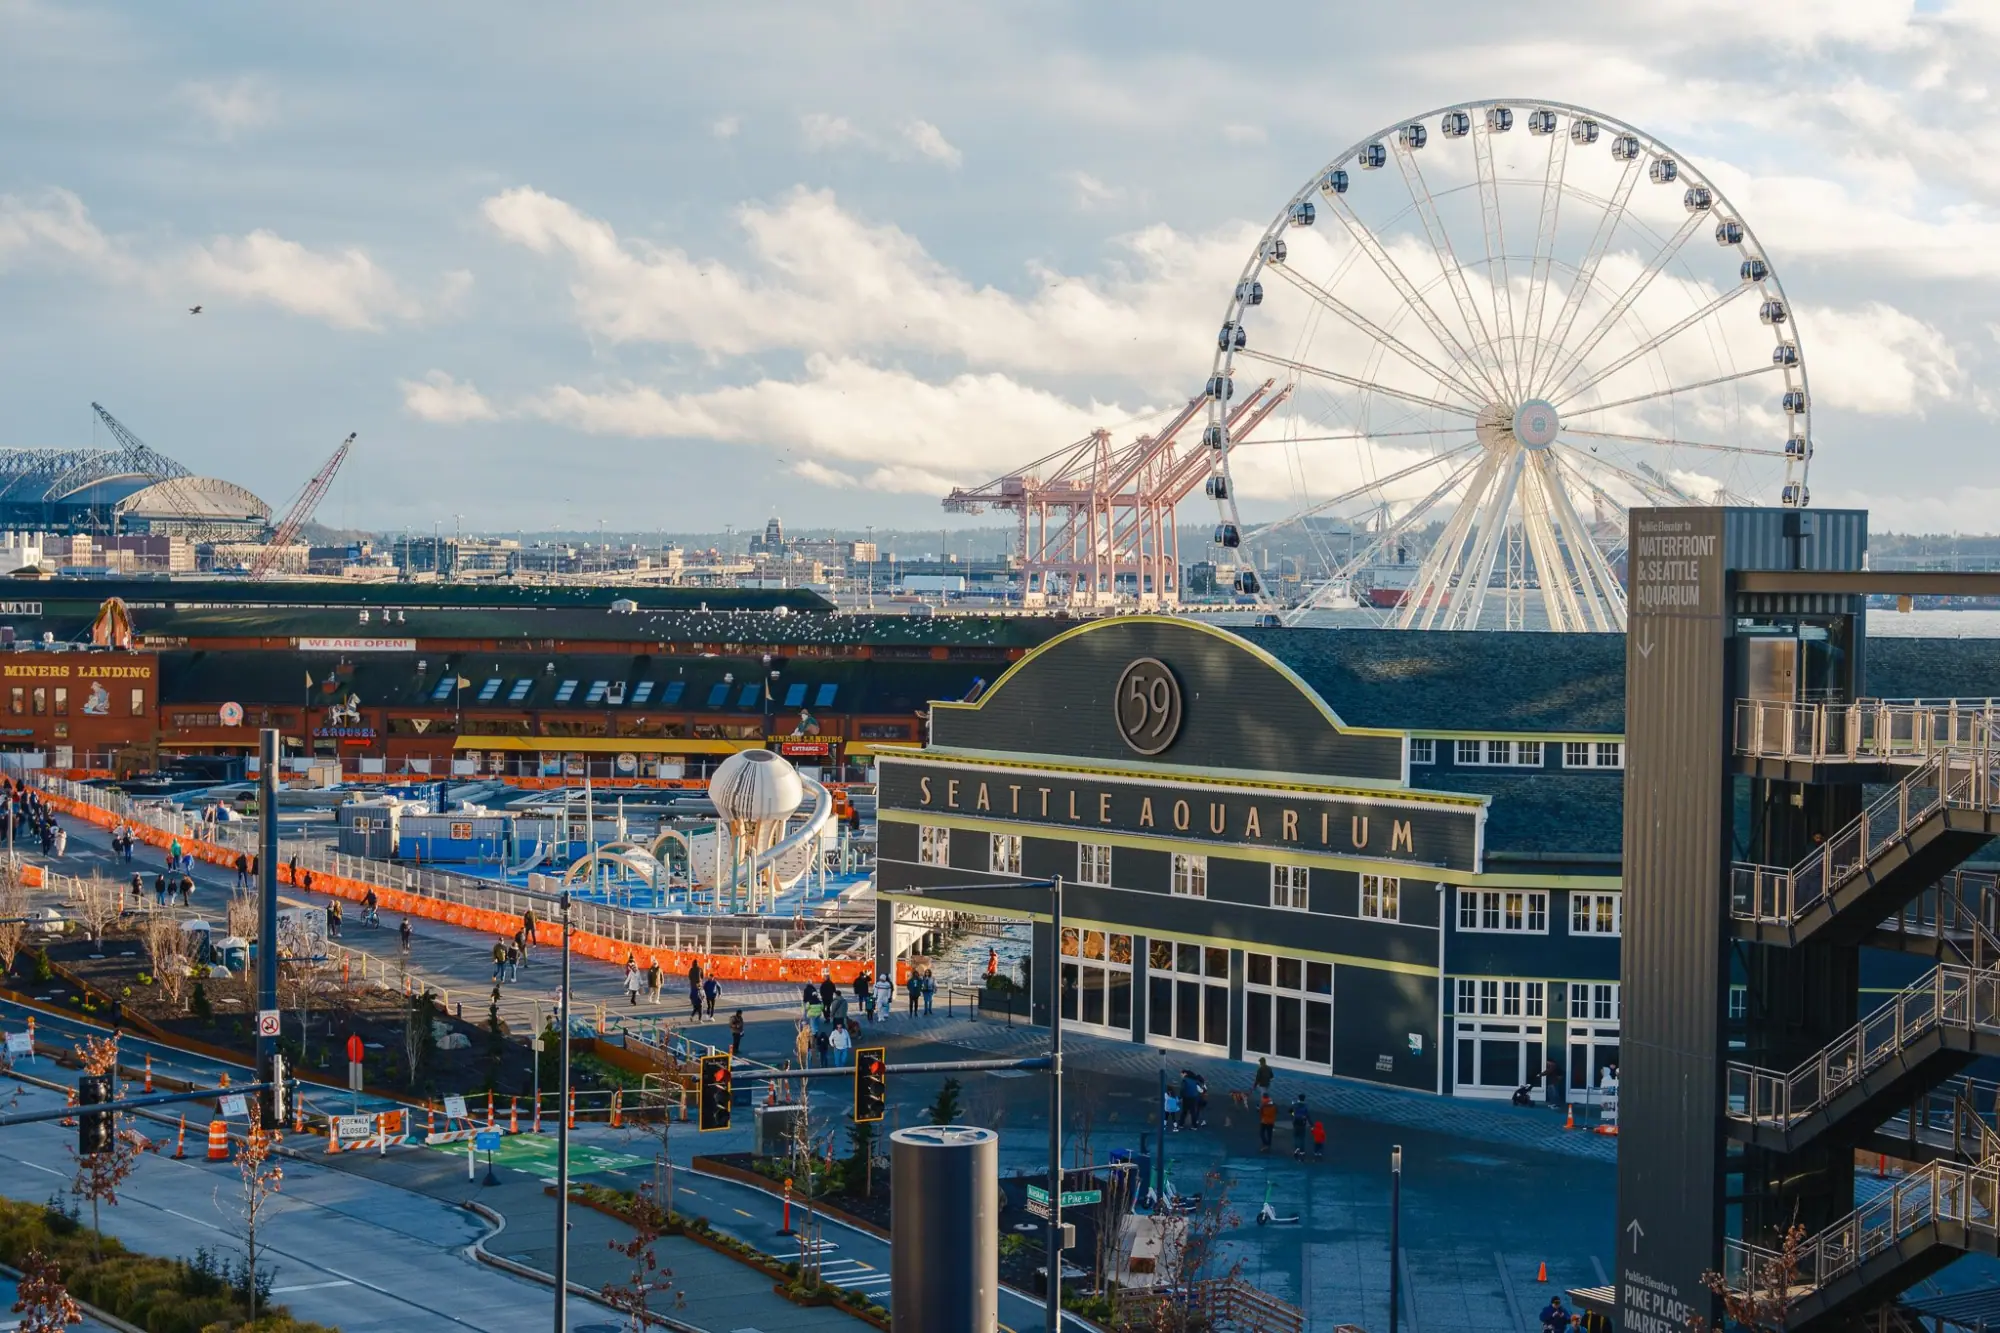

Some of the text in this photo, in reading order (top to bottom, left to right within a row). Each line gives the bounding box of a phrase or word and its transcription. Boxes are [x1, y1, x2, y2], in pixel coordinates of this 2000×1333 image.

[1638, 535, 1717, 557] WATERFRONT
[1638, 560, 1698, 581] & SEATTLE
[1638, 585, 1700, 608] AQUARIUM
[308, 639, 408, 648] WE ARE OPEN!
[4, 665, 152, 678] MINERS LANDING
[1129, 676, 1170, 737] 59
[312, 727, 377, 738] CAROUSEL
[804, 735, 844, 743] LANDING
[920, 776, 1414, 853] SEATTLE AQUARIUM
[342, 1127, 368, 1135] CLOSED
[1067, 1194, 1082, 1204] Pike
[1625, 1269, 1677, 1296] Public Elevator to
[1624, 1283, 1691, 1325] PIKE PLACE
[1624, 1307, 1673, 1333] MARKET
